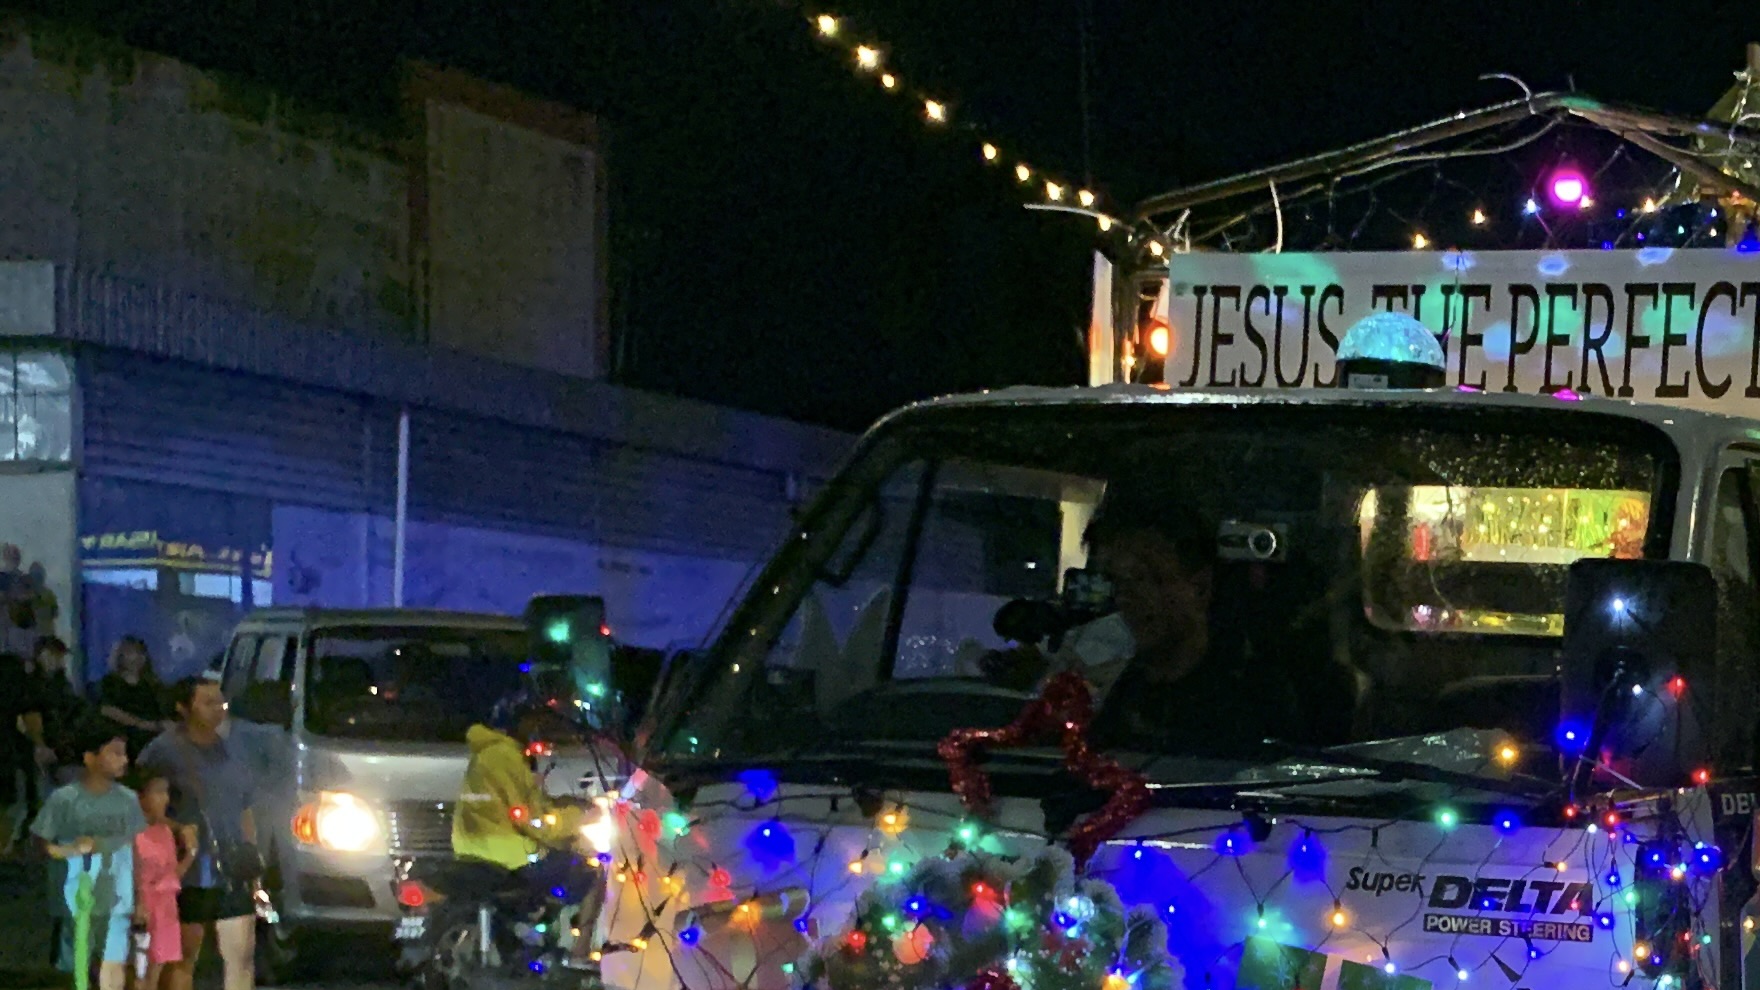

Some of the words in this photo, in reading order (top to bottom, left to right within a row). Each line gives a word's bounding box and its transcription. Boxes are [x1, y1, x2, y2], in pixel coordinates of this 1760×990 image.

[1179, 283, 1345, 389] JESUS
[1345, 865, 1426, 894] Super
[1427, 875, 1595, 917] DELTA
[1426, 915, 1492, 935] POWER
